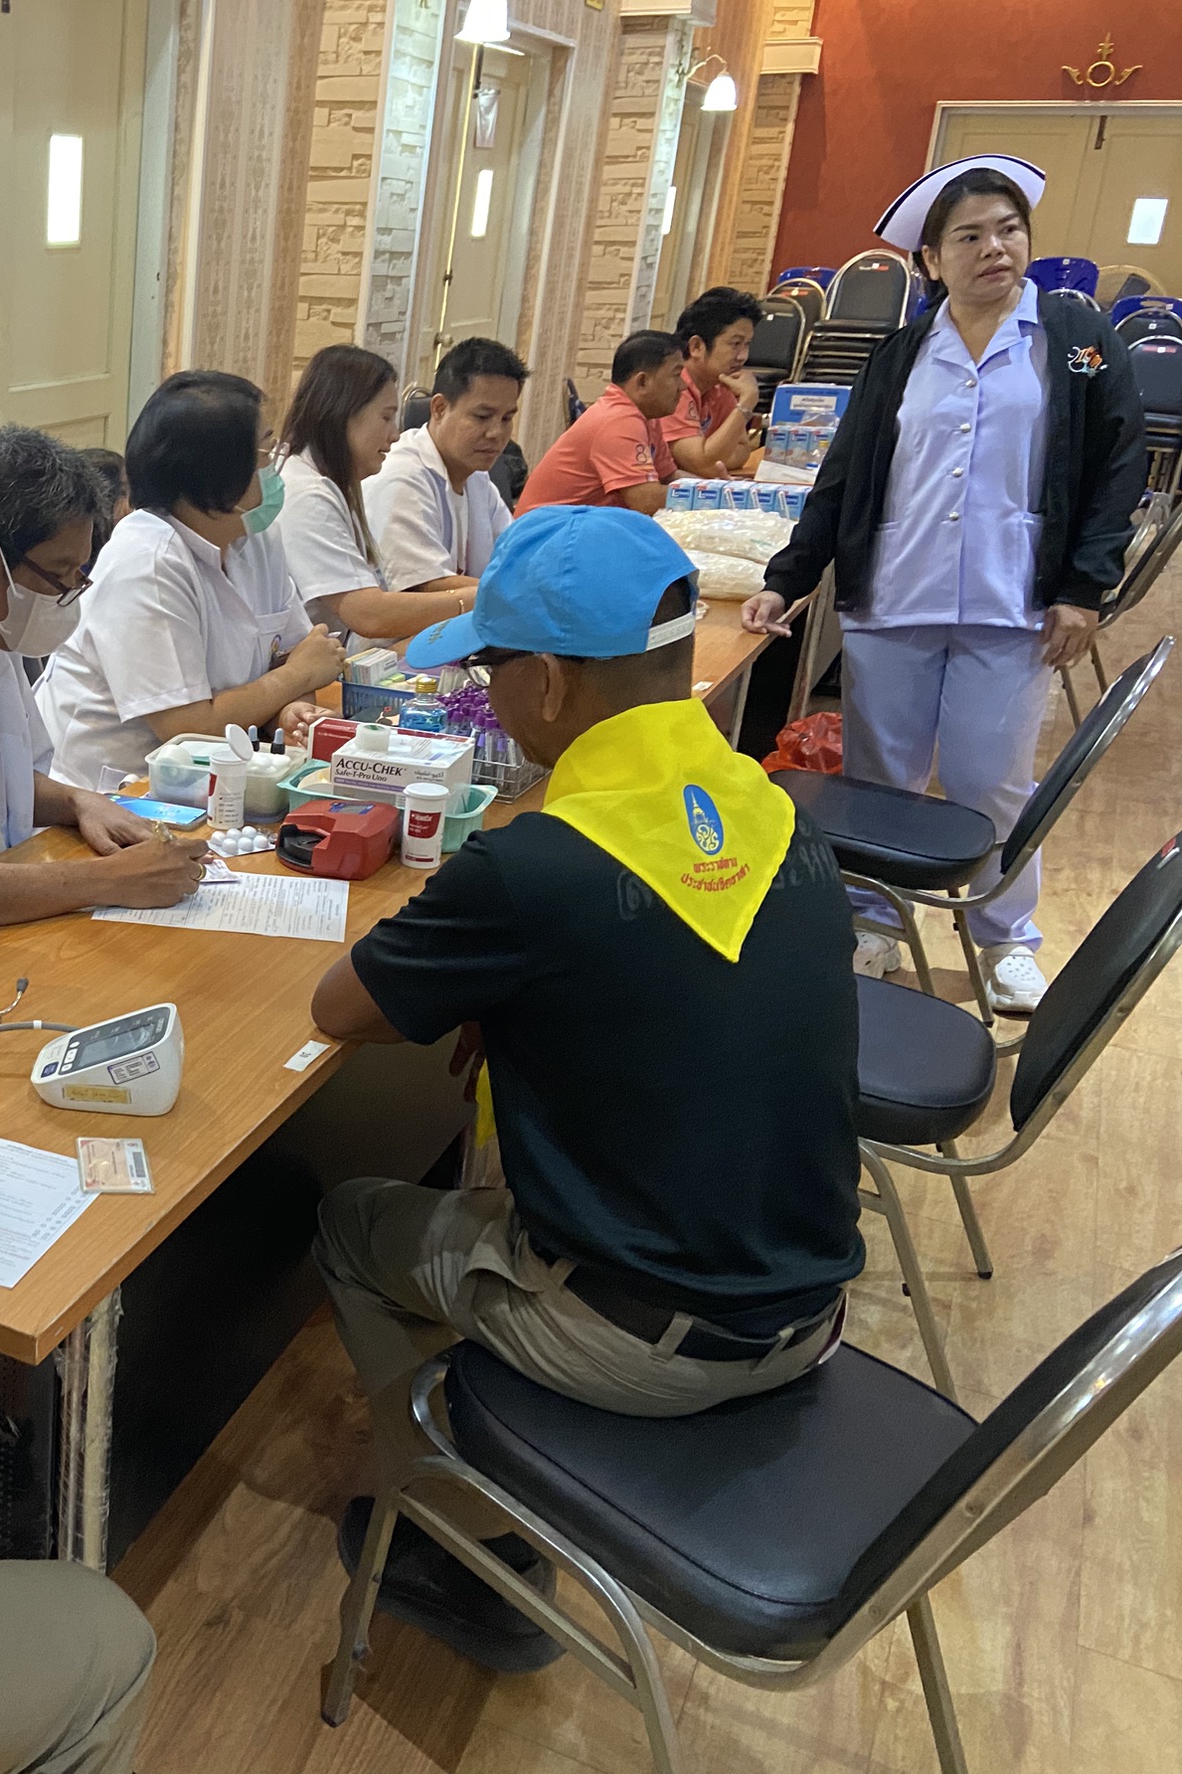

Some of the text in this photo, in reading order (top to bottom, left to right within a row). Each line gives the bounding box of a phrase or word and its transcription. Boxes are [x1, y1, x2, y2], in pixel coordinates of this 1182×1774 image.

[335, 768, 388, 782] Safe-T-Pro Uno
[336, 758, 403, 776] ACCU-CHEK
[693, 856, 738, 873] พระราชทาน
